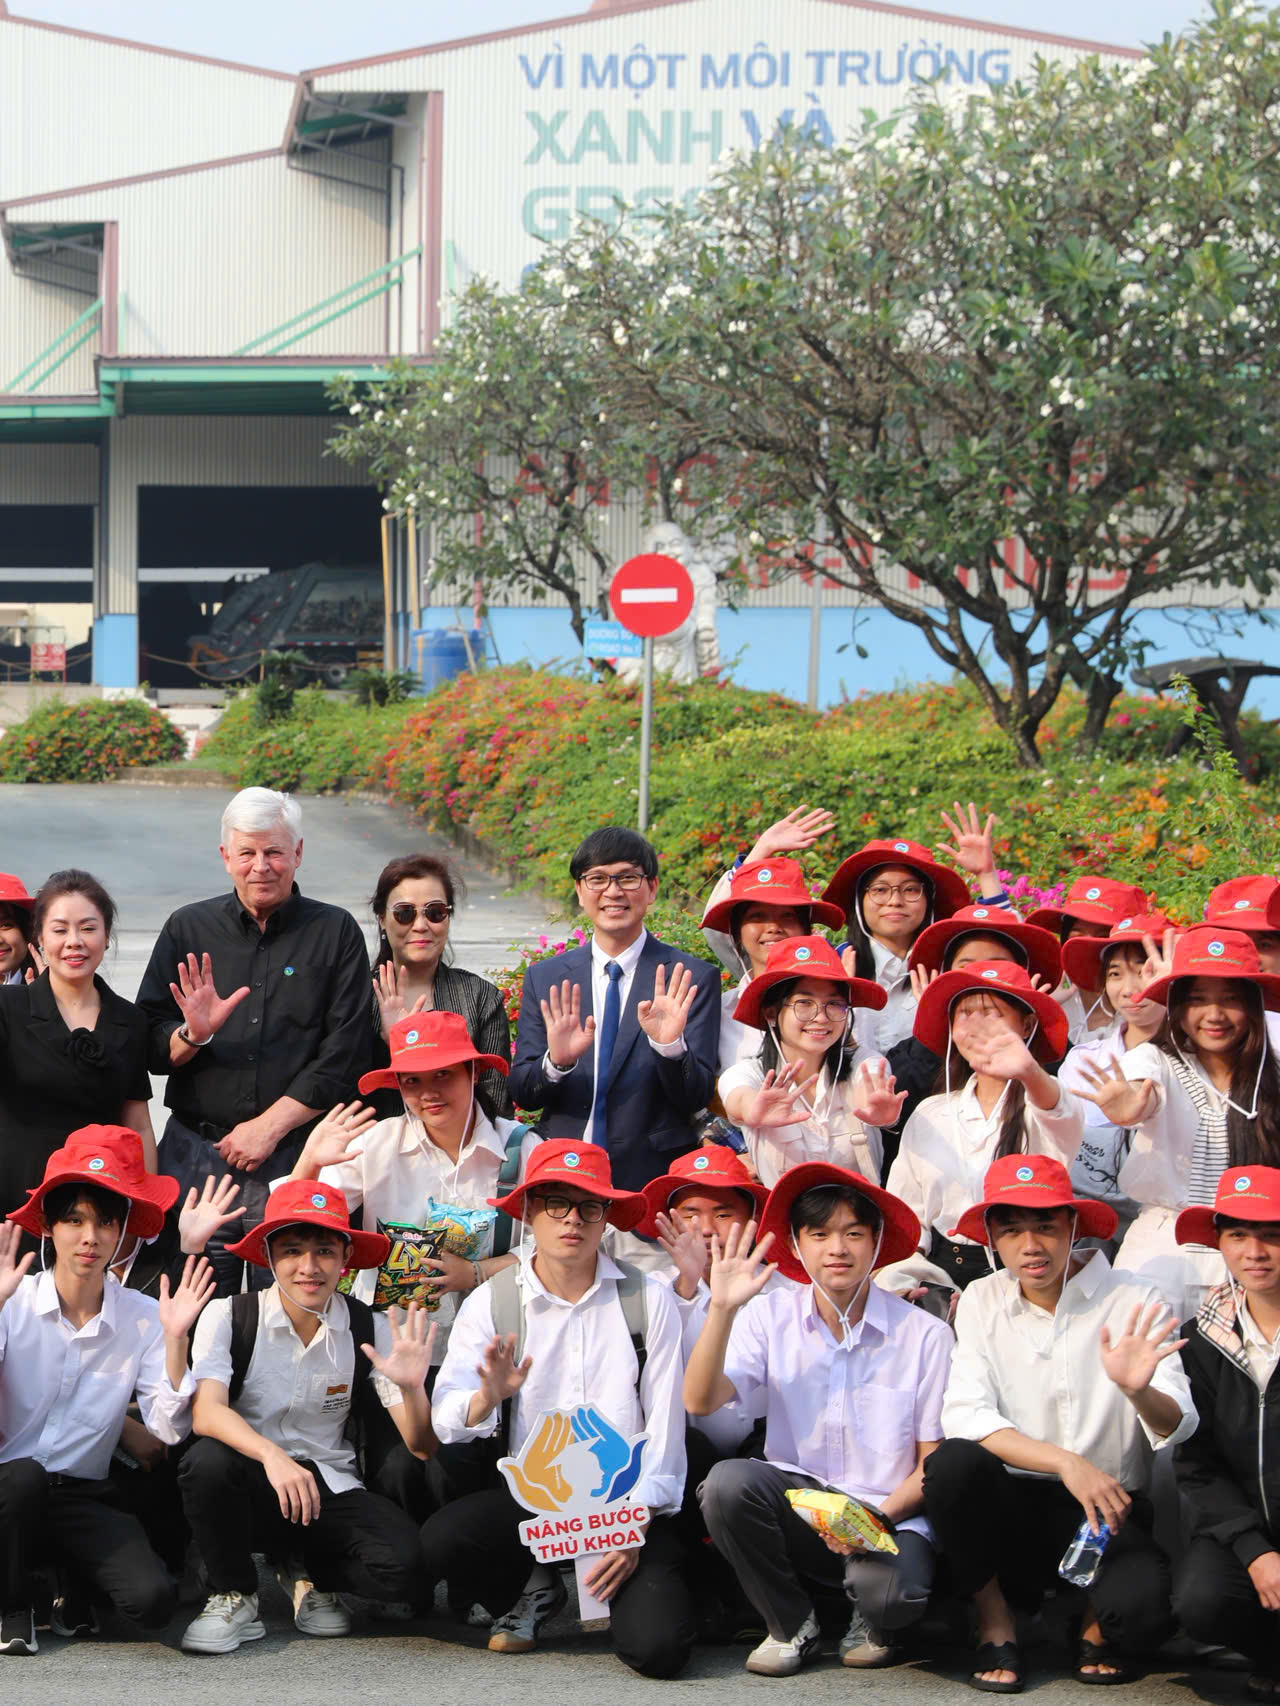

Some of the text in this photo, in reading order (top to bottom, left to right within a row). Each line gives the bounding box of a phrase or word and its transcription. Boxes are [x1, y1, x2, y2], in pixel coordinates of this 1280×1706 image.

[519, 39, 1011, 99] VÌ MỘT MÔI TRƯỜNG
[523, 109, 722, 165] XANH
[526, 1506, 646, 1541] NÂNG BƯỚC
[538, 1529, 641, 1559] THỦ KHOA
